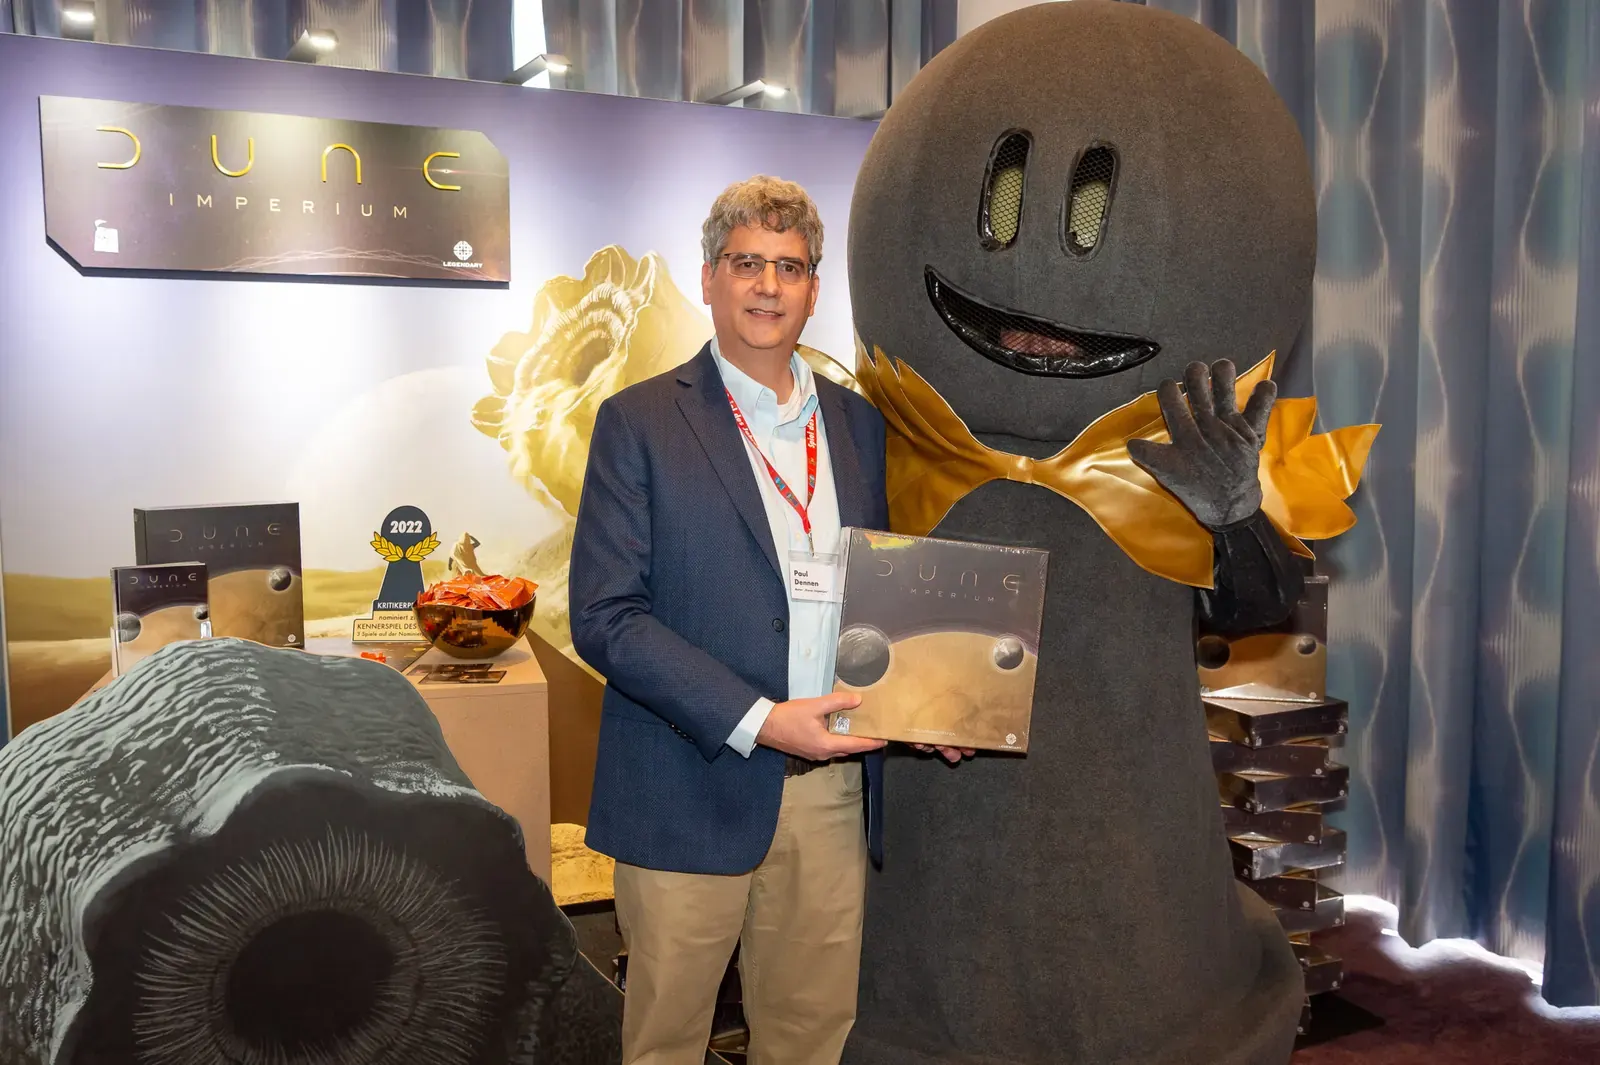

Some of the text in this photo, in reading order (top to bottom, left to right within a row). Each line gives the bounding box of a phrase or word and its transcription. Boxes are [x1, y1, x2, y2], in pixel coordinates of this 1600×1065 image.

[96, 127, 461, 191] DUNE
[169, 193, 408, 219] IMPERIUM
[806, 431, 816, 448] Spiel
[169, 523, 281, 542] DUNE
[390, 520, 423, 534] 2022
[130, 573, 197, 585] DUNE
[794, 579, 819, 587] Dennen
[876, 559, 1021, 593] DUNE
